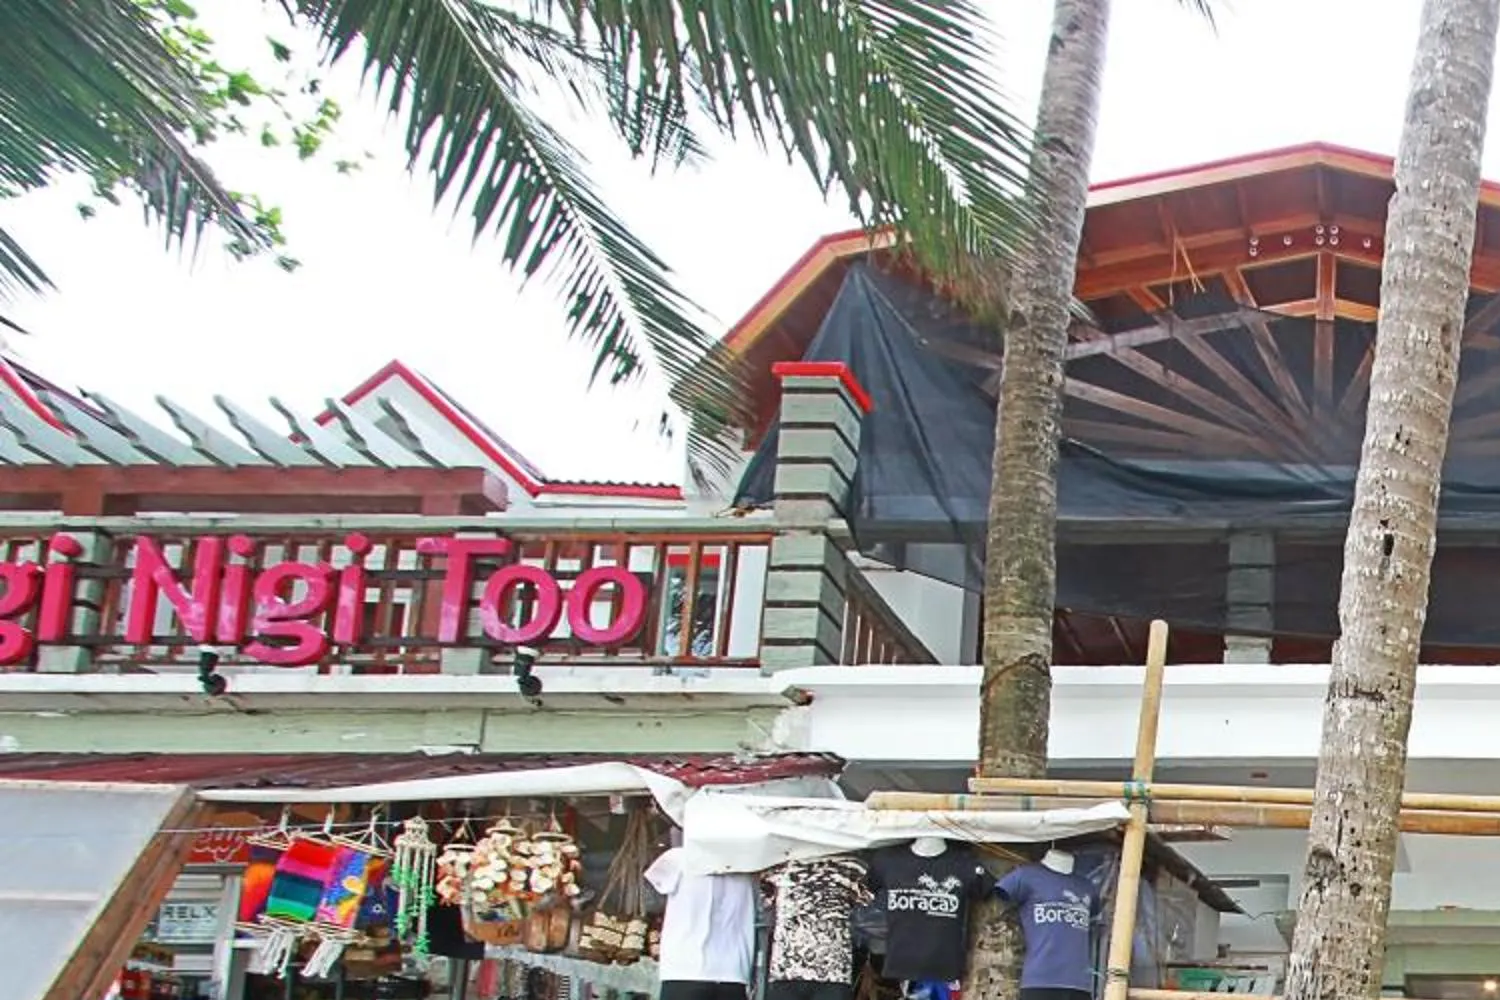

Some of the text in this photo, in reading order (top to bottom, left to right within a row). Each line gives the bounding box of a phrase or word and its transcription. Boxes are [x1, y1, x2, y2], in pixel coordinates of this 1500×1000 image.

[125, 533, 372, 665] Nigi
[416, 537, 648, 645] Too
[163, 905, 217, 919] RELX
